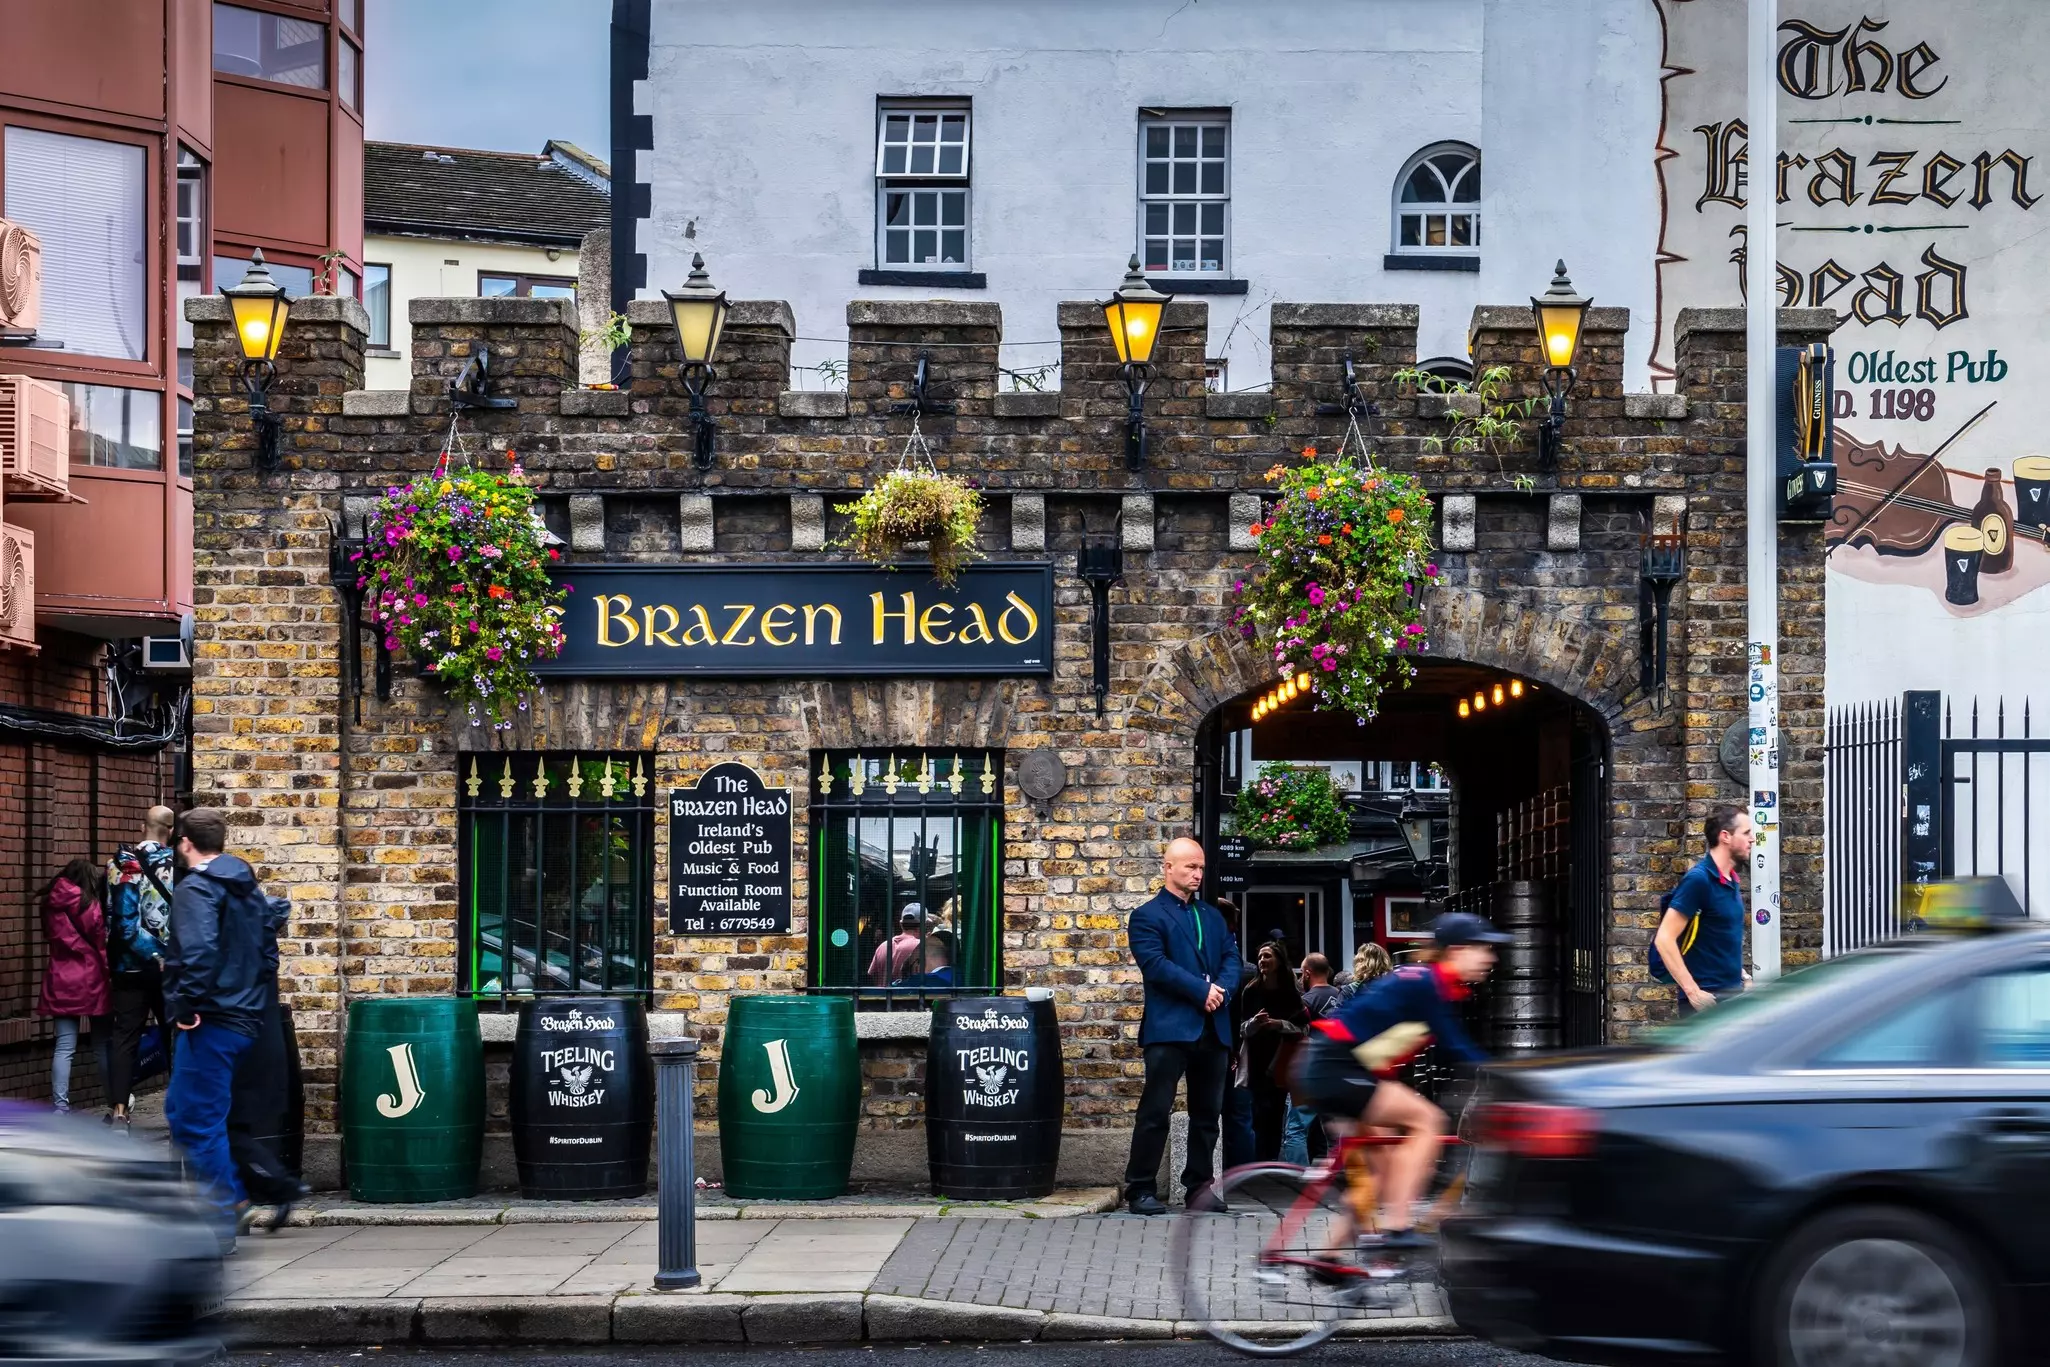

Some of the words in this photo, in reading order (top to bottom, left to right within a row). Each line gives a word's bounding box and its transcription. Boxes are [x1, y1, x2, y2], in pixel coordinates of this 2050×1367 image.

[1776, 15, 1949, 100] The
[1848, 350, 1938, 384] Oldest
[1946, 350, 2008, 383] Pub
[1812, 379, 1822, 419] GUINNESS
[1869, 388, 1936, 422] 1198
[593, 593, 842, 647] Brazen
[869, 591, 1039, 646] Head
[714, 776, 748, 793] The
[743, 797, 788, 816] Head
[698, 823, 764, 837] Ireland's
[688, 841, 736, 854] Oldest
[743, 841, 773, 854] Pub
[683, 862, 723, 875] Music
[728, 863, 741, 875] &
[748, 862, 779, 874] Food
[678, 884, 738, 897] Function
[745, 885, 783, 896] Room
[700, 899, 761, 911] Available
[685, 918, 704, 930] Tel
[720, 918, 775, 930] 6779549
[569, 1009, 582, 1020] the
[984, 1008, 997, 1019] the
[541, 1016, 583, 1032] Brazen
[584, 1016, 615, 1032] Head
[956, 1016, 999, 1032] Brazen
[999, 1015, 1029, 1031] Head
[541, 1047, 615, 1072] TEELING
[956, 1047, 1029, 1071] TEELING
[548, 1089, 605, 1108] WHISKEY
[963, 1089, 1019, 1107] WHISKEY
